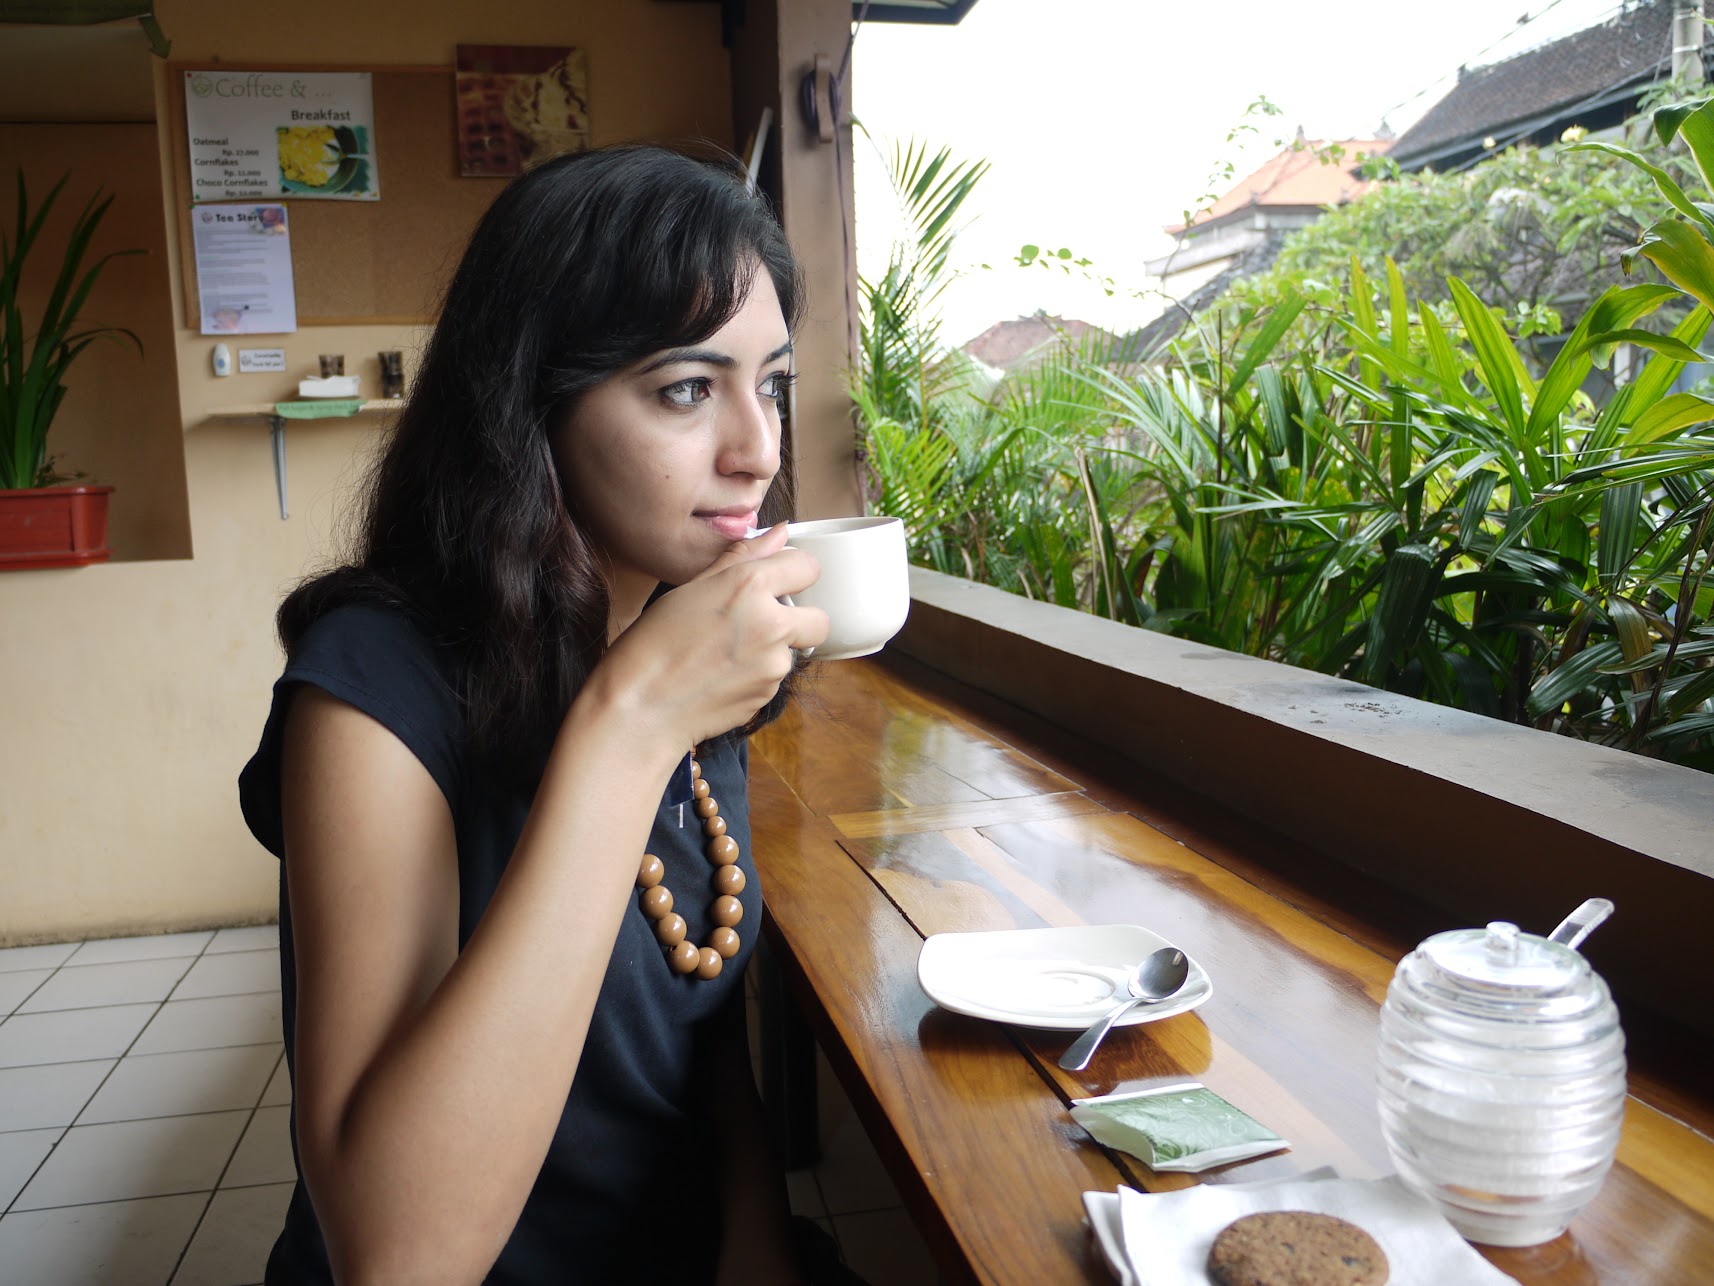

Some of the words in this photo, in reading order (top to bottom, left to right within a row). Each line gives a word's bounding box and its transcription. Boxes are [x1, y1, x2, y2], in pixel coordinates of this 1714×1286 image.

[215, 74, 284, 98] Coffee
[290, 80, 308, 99] &
[291, 109, 352, 121] Breakfast
[193, 137, 229, 146] Oatmeal
[194, 158, 239, 167] Cornflakes
[196, 179, 223, 187] Choco
[224, 178, 268, 187] Cornflakes
[237, 213, 265, 224] Story
